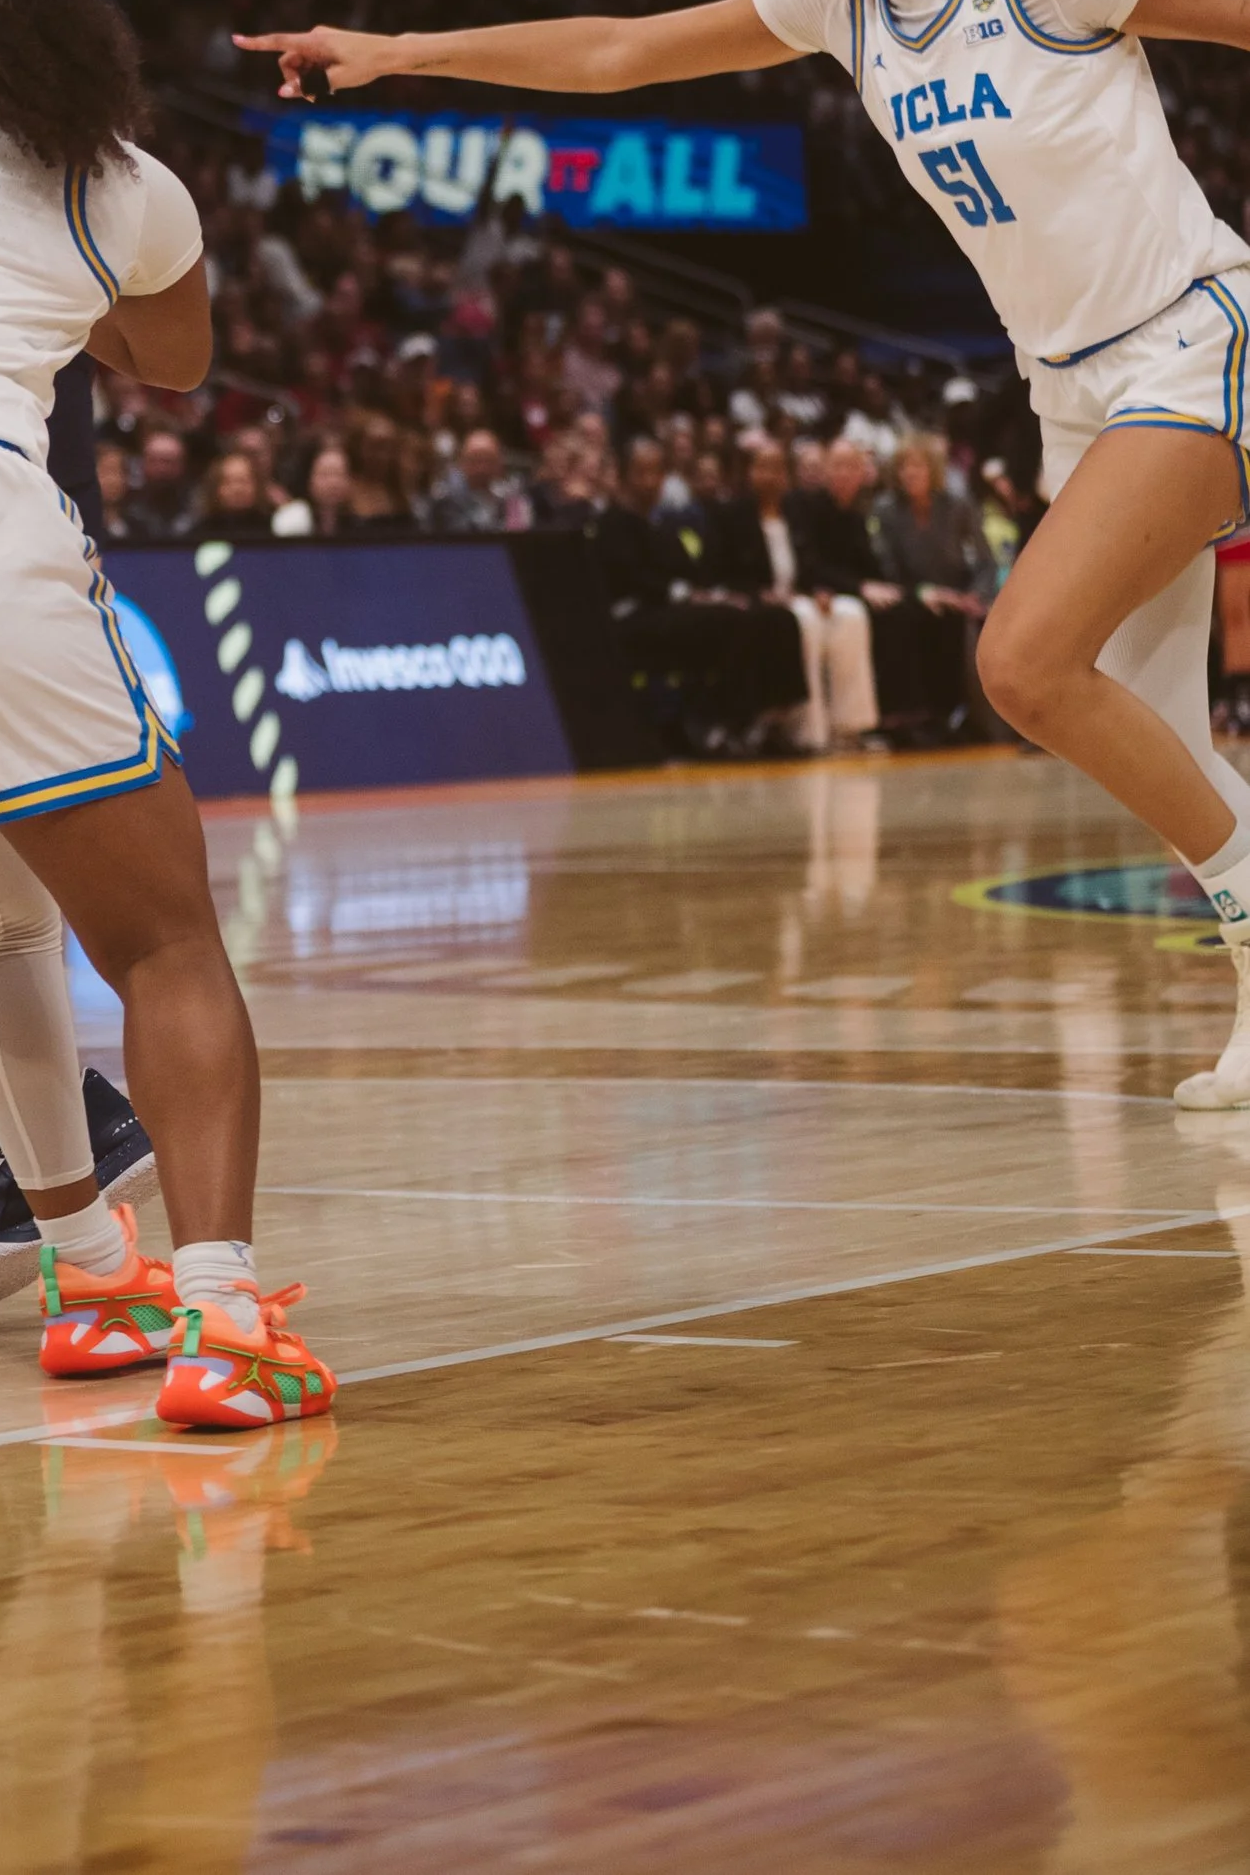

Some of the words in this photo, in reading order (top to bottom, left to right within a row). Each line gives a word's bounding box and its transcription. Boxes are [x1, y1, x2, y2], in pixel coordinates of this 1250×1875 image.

[298, 124, 547, 217] FOUR
[590, 129, 758, 218] ALL
[918, 139, 1017, 228] 51
